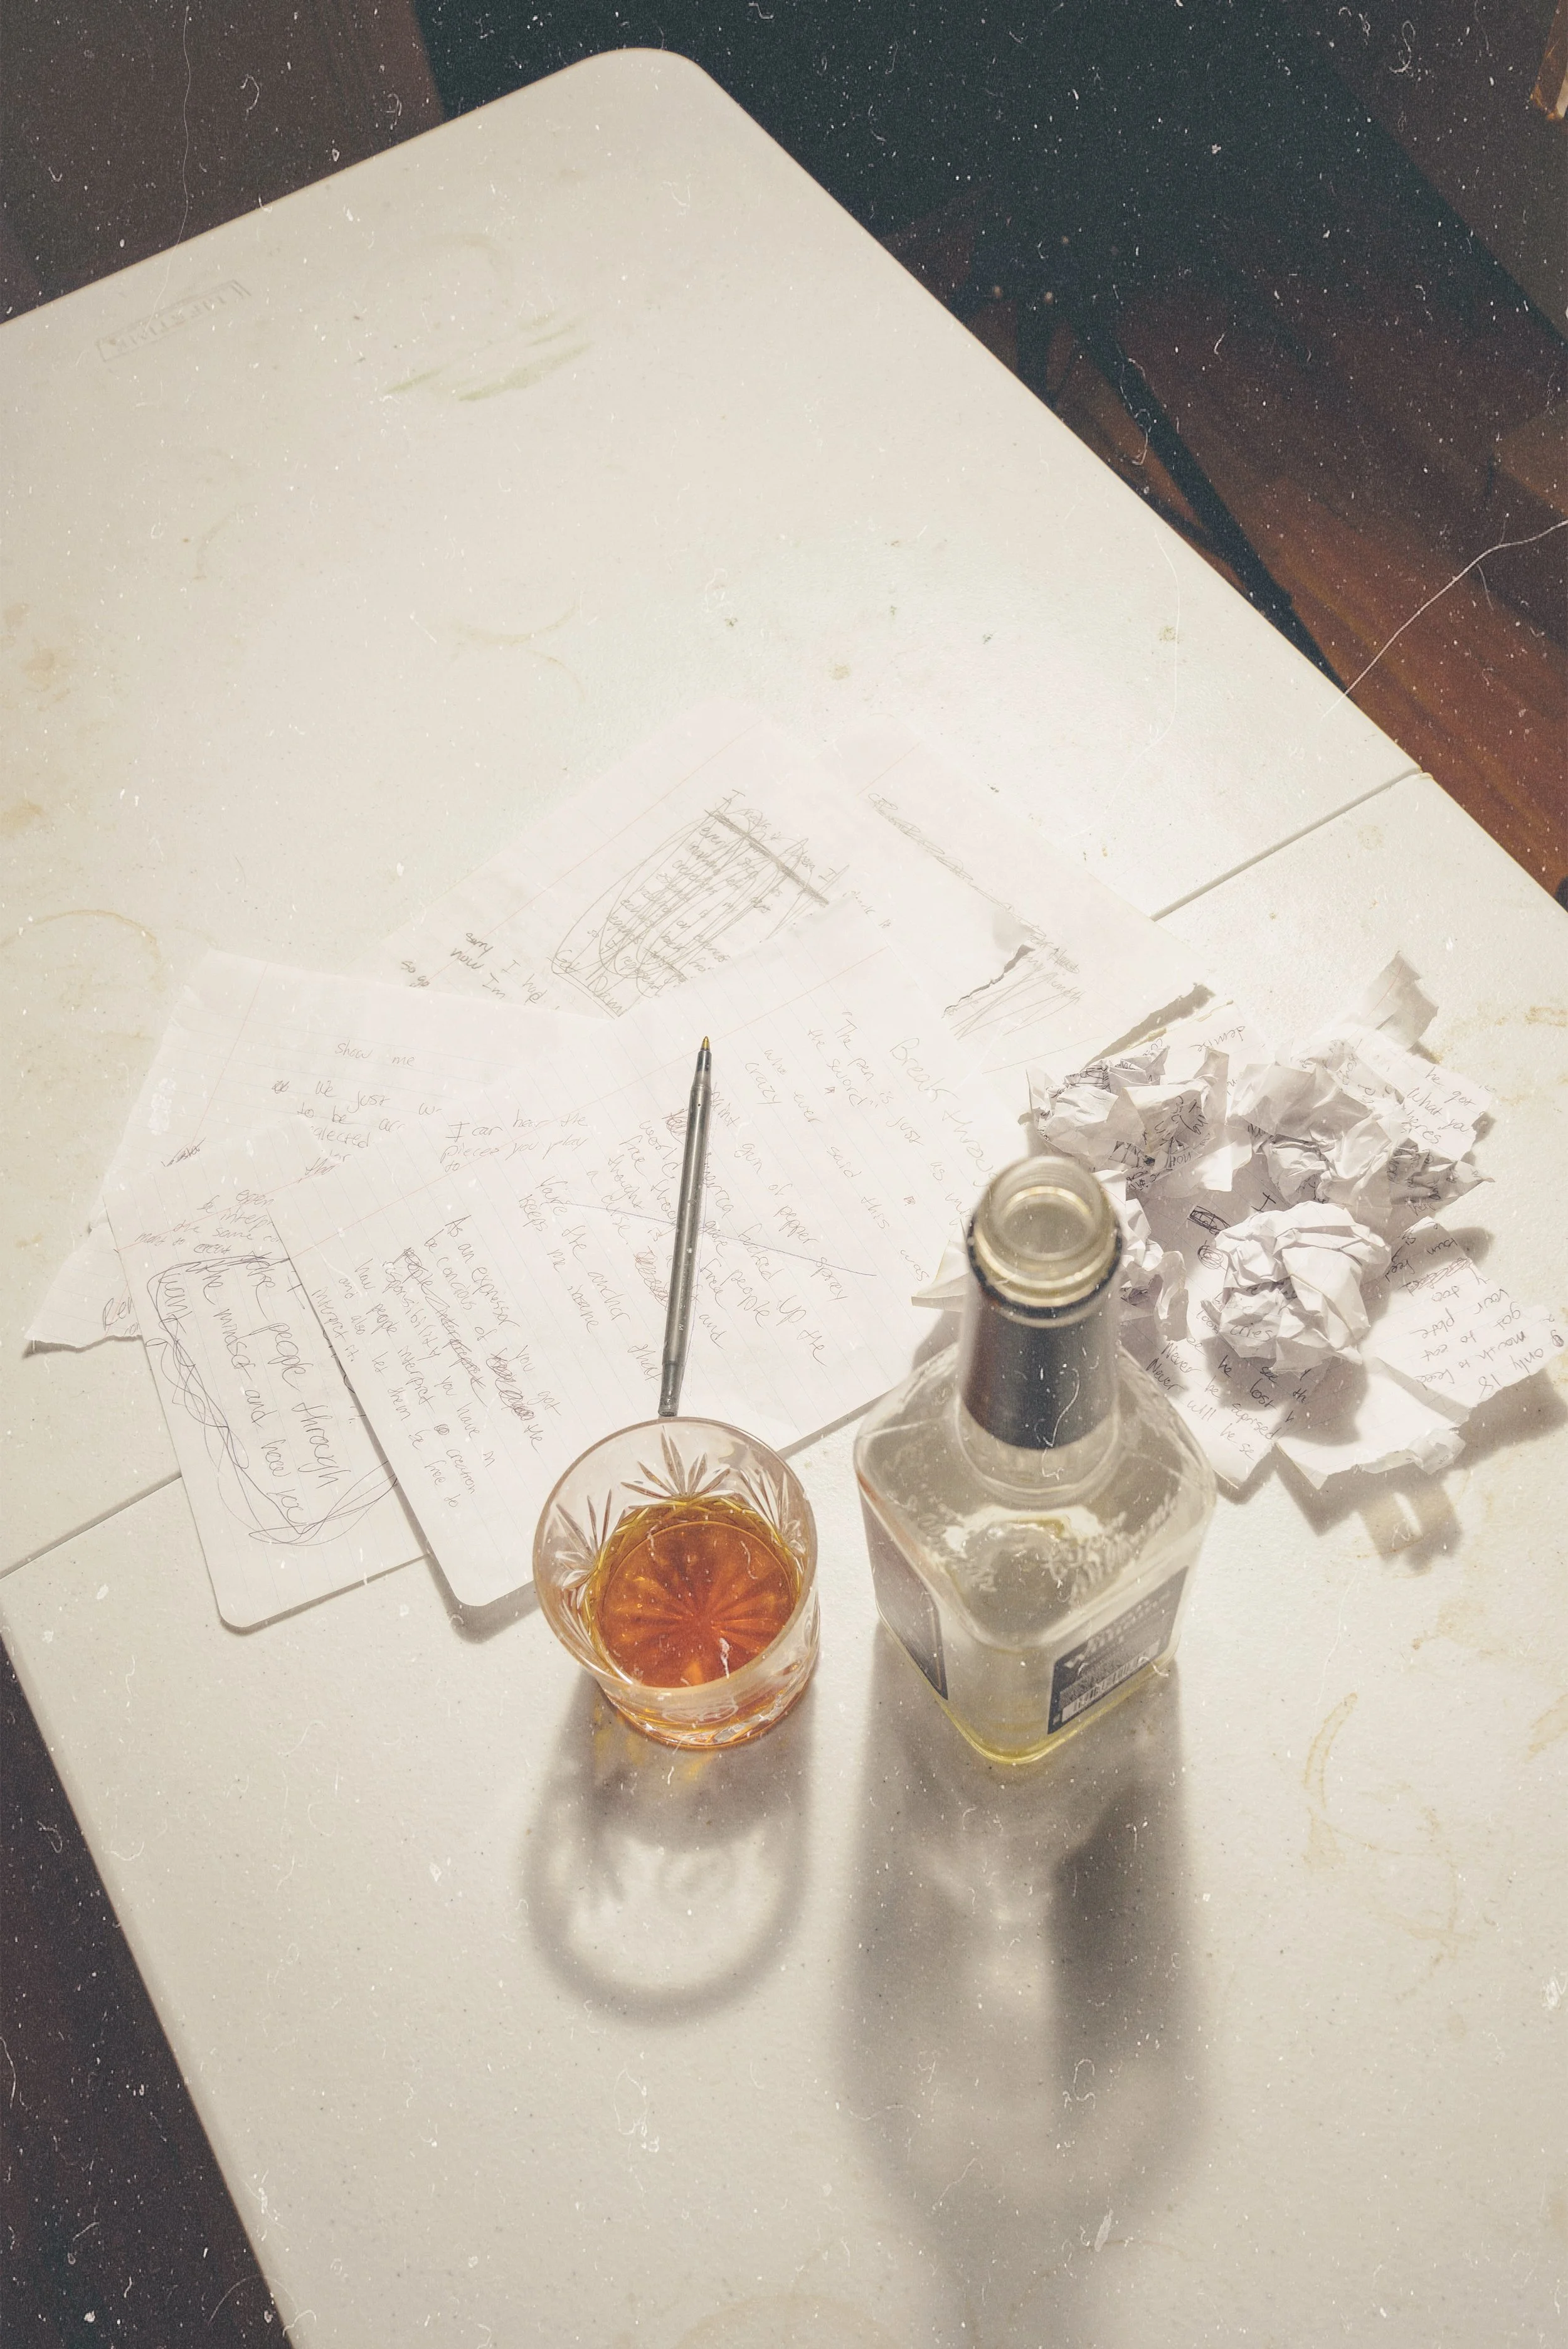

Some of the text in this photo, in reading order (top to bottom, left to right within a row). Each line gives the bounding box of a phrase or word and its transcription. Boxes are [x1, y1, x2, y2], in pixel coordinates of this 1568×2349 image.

[450, 948, 484, 969] now
[807, 1029, 825, 1050] the
[335, 1041, 416, 1068] show me
[744, 1063, 782, 1105] crazy
[847, 1058, 874, 1082] pen
[347, 1091, 391, 1114] just
[879, 1091, 894, 1104] is
[889, 1037, 960, 1103] Break
[941, 1110, 999, 1187] throug
[1407, 1088, 1443, 1116] what
[1444, 1090, 1476, 1108] got
[297, 1102, 351, 1125] to be
[446, 1121, 470, 1139] I
[512, 1109, 551, 1129] hear
[559, 1113, 590, 1128] the
[886, 1116, 924, 1145] just
[506, 1142, 536, 1160] you
[543, 1135, 589, 1160] play
[618, 1135, 654, 1177] free
[734, 1143, 762, 1174] gun
[443, 1162, 460, 1173] to
[586, 1170, 599, 1189] a
[763, 1049, 930, 1281] who ever said this was
[930, 1162, 945, 1181] as
[768, 1183, 793, 1196] of
[213, 1228, 257, 1241] same
[444, 1214, 472, 1238] As
[518, 1194, 546, 1232] keeps
[546, 1249, 566, 1273] me
[773, 1205, 818, 1256] pepper
[457, 1243, 475, 1264] an
[561, 1225, 587, 1263] the
[587, 1271, 631, 1321] anchor
[721, 1269, 770, 1329] people
[367, 1302, 401, 1337] people
[699, 1314, 727, 1350] and
[776, 1295, 807, 1323] up
[798, 1329, 827, 1367] the
[1410, 1307, 1455, 1339] plate
[423, 1228, 445, 1253] be
[474, 1327, 495, 1342] of
[523, 1424, 544, 1453] the
[1459, 1330, 1476, 1343] to
[1476, 1330, 1526, 1361] mouth
[507, 1344, 536, 1372] you
[1162, 1342, 1204, 1374] Never
[1420, 1344, 1448, 1362] eat
[1459, 1359, 1471, 1369] to
[1510, 1348, 1544, 1374] only
[213, 1308, 256, 1381] mindset
[243, 1389, 271, 1428] and
[1147, 1357, 1184, 1391] Never
[1259, 1367, 1278, 1384] see
[247, 1322, 306, 1392] people
[291, 1401, 351, 1488] through
[338, 1278, 356, 1299] and
[351, 1315, 367, 1335] also
[371, 1351, 389, 1375] let
[387, 1387, 411, 1421] them
[424, 1460, 447, 1486] free
[443, 1493, 461, 1508] to
[433, 1375, 457, 1396] you
[456, 1402, 480, 1439] have
[1251, 1379, 1277, 1410] lost
